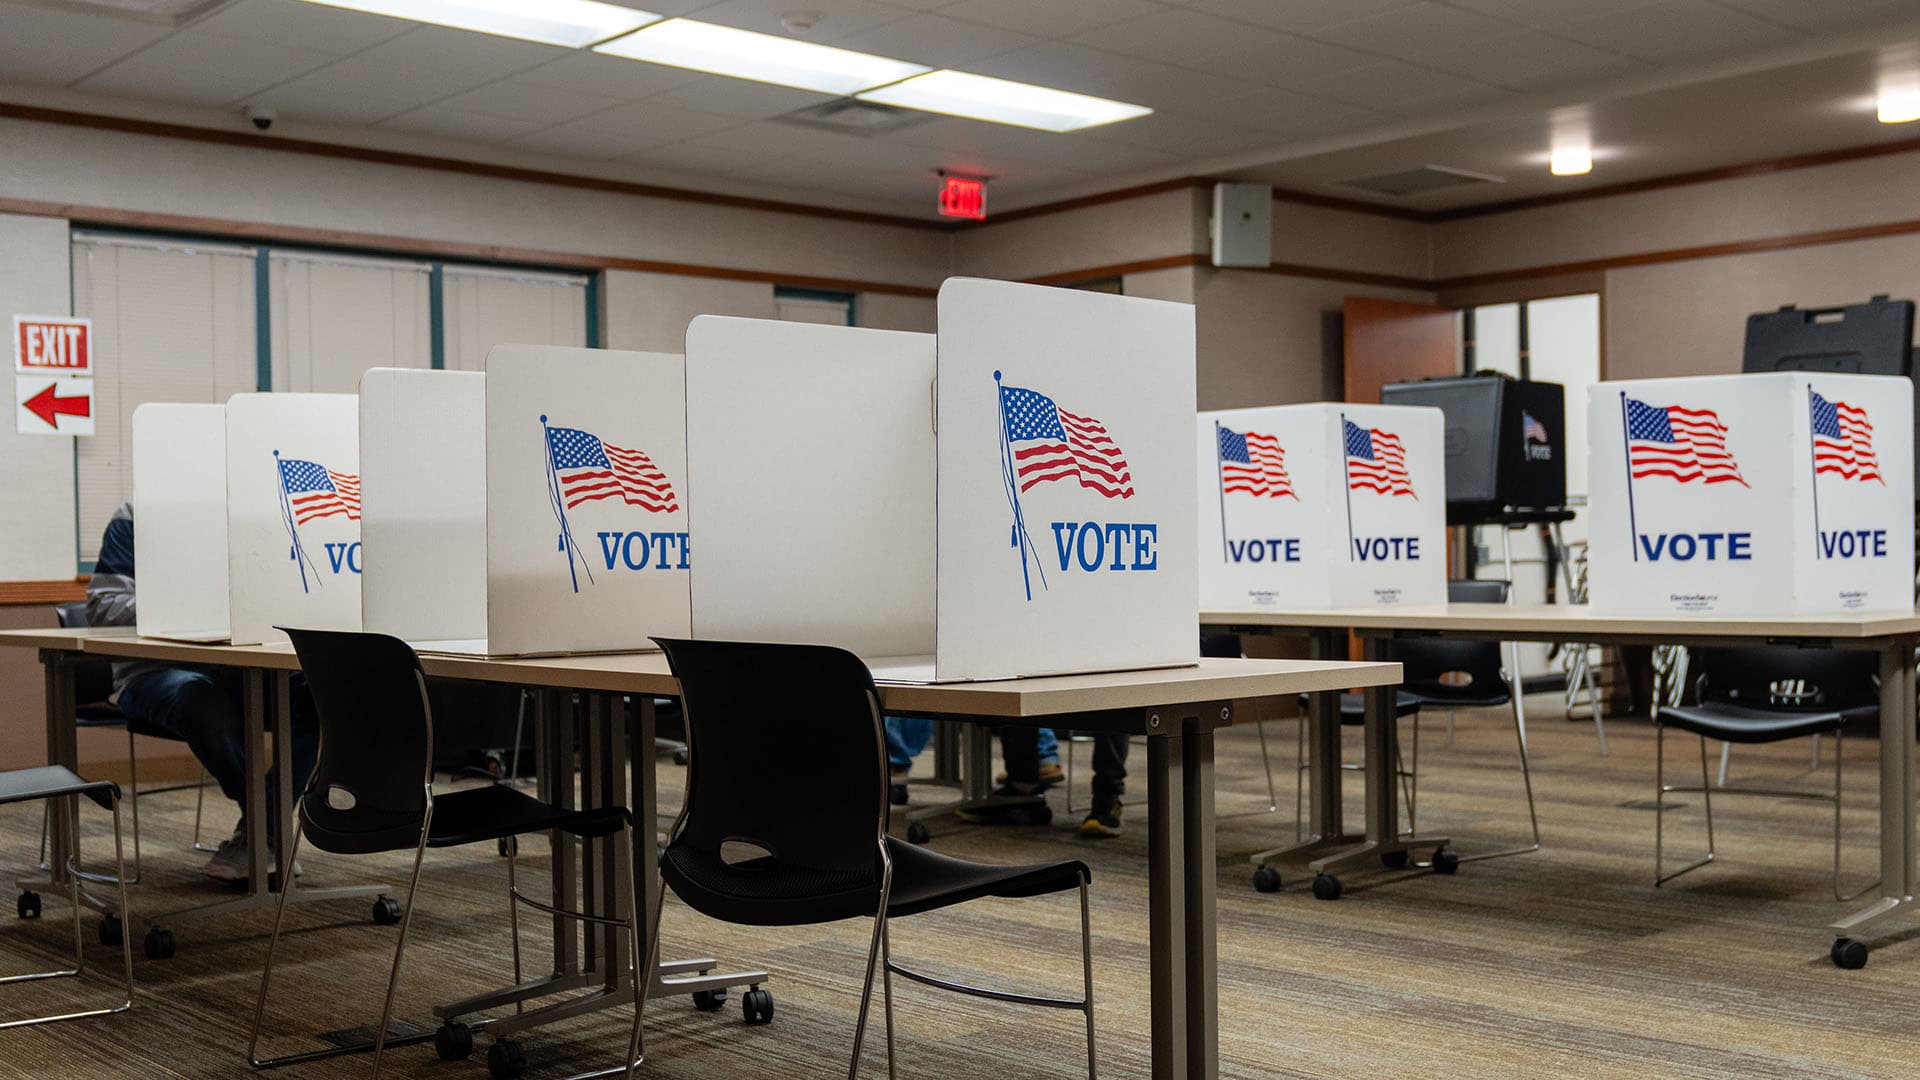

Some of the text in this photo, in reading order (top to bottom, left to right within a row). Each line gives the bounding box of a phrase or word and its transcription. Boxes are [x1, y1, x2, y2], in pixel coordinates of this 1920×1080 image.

[26, 325, 81, 366] EXIT
[324, 542, 362, 574] VO
[1051, 521, 1157, 572] VOTE
[1229, 540, 1300, 562] VOTE
[1355, 538, 1420, 561] VOTE
[1640, 533, 1752, 561] VOTE
[1821, 530, 1887, 558] VOTE
